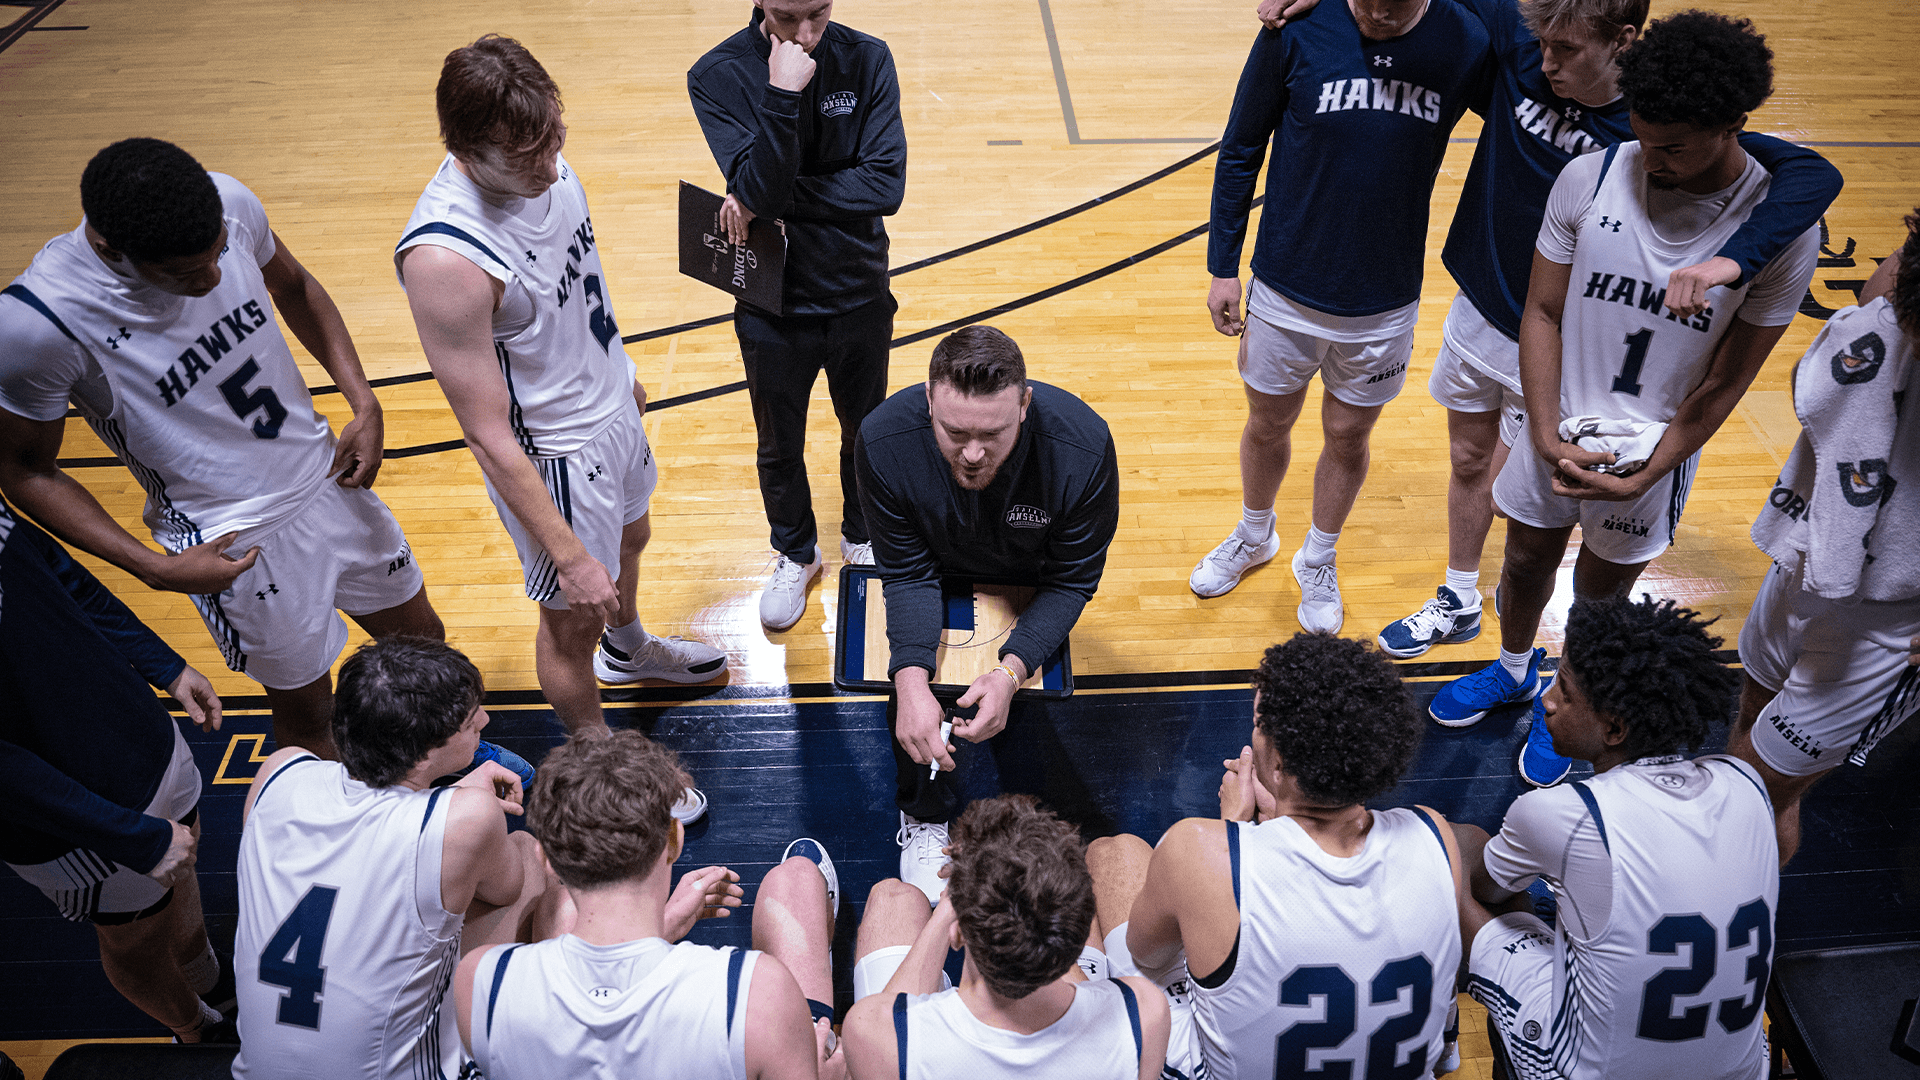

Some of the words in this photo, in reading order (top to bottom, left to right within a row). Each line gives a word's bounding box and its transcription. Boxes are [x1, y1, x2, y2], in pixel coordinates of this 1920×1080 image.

[1315, 77, 1441, 124] HAWKS
[1514, 97, 1603, 155] HAW
[154, 298, 268, 409] HAWKS
[583, 272, 619, 358] 2
[215, 353, 290, 440] 5
[1609, 326, 1656, 398] 1
[1601, 518, 1650, 538] ANSELM
[1769, 714, 1823, 760] ANSELM
[257, 882, 341, 1032] 4
[1635, 894, 1772, 1043] 23
[1272, 950, 1435, 1080] 22
